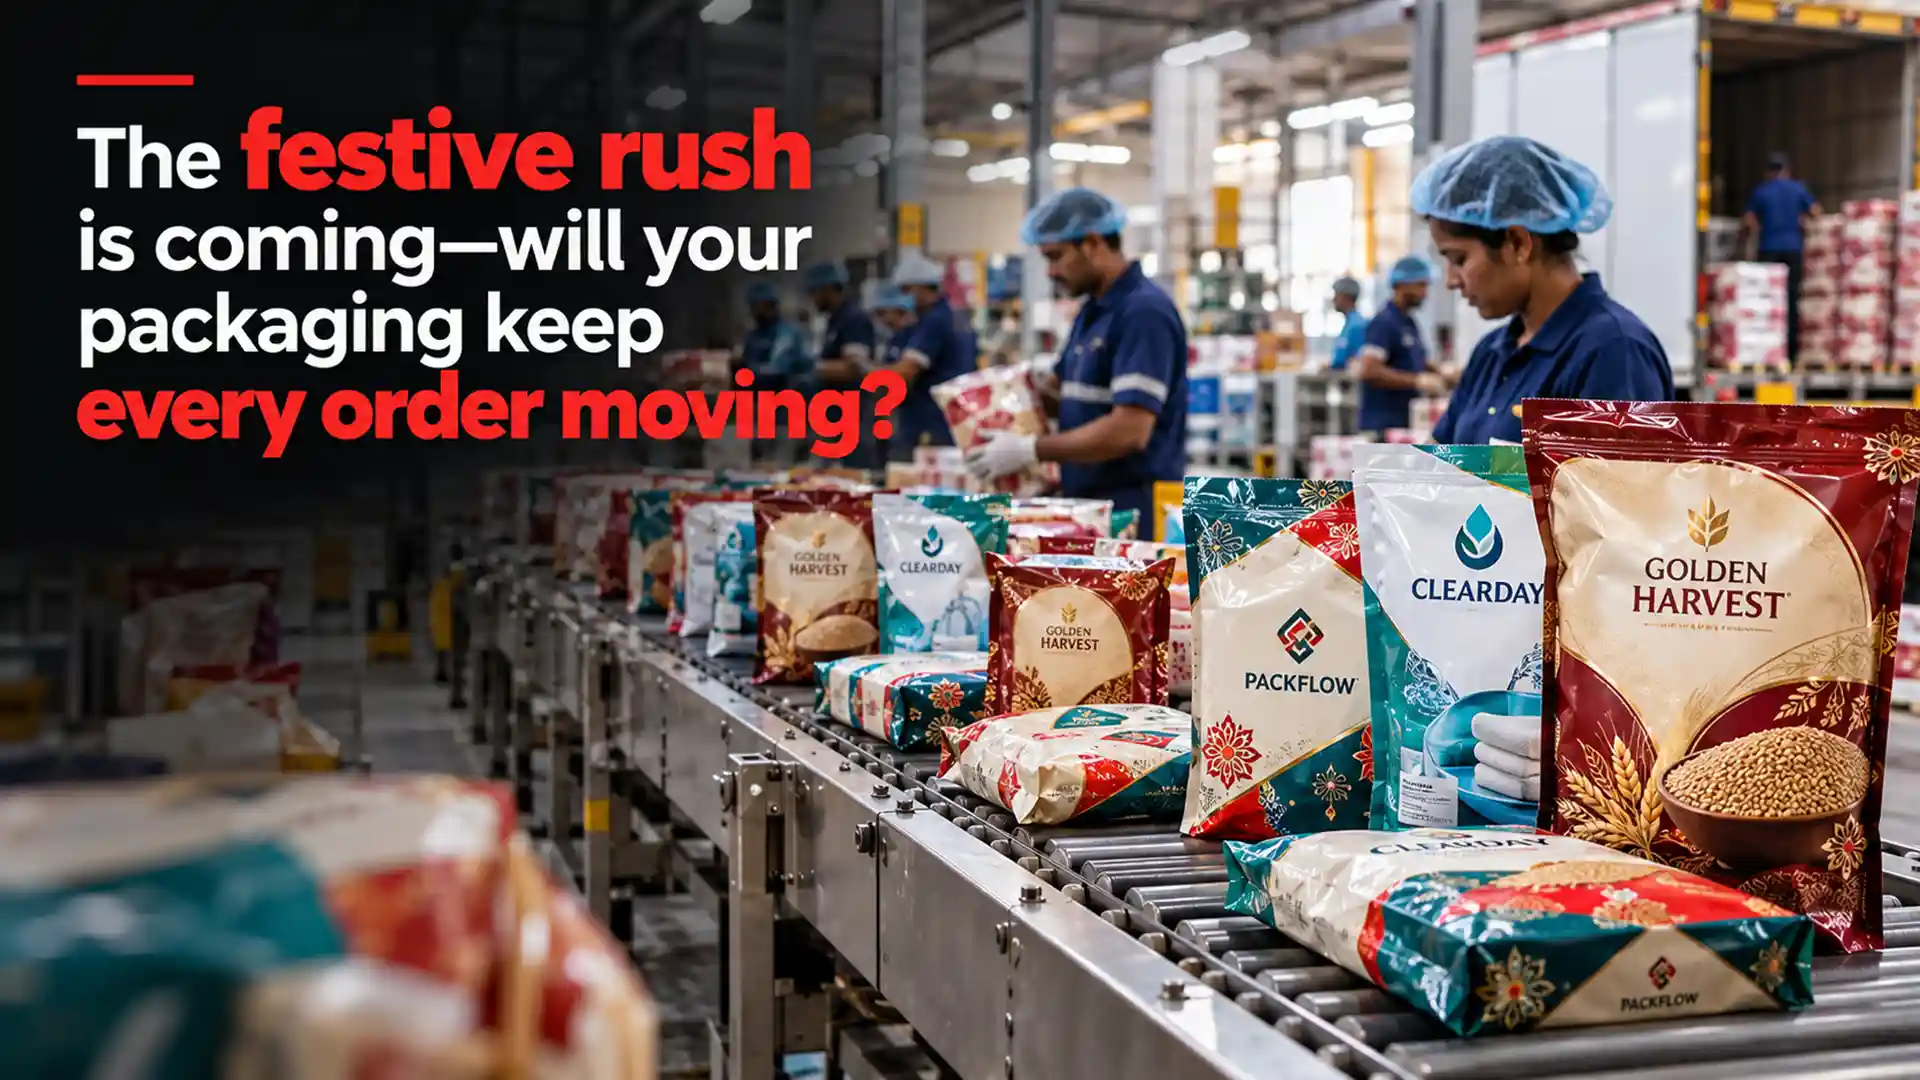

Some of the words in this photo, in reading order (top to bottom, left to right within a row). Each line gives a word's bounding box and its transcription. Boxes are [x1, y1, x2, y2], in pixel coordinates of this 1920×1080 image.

[794, 552, 841, 562] GOLDEN
[789, 563, 849, 576] HARVEST
[900, 561, 963, 574] CLEARDAY
[1645, 557, 1767, 585] GOLDEN
[1411, 577, 1544, 604] CLEARDAY
[1045, 626, 1092, 636] GOLDEN
[1041, 637, 1099, 651] HARVEST
[1245, 672, 1356, 694] PACKFLOW
[1620, 992, 1699, 1012] PACKFLOW
